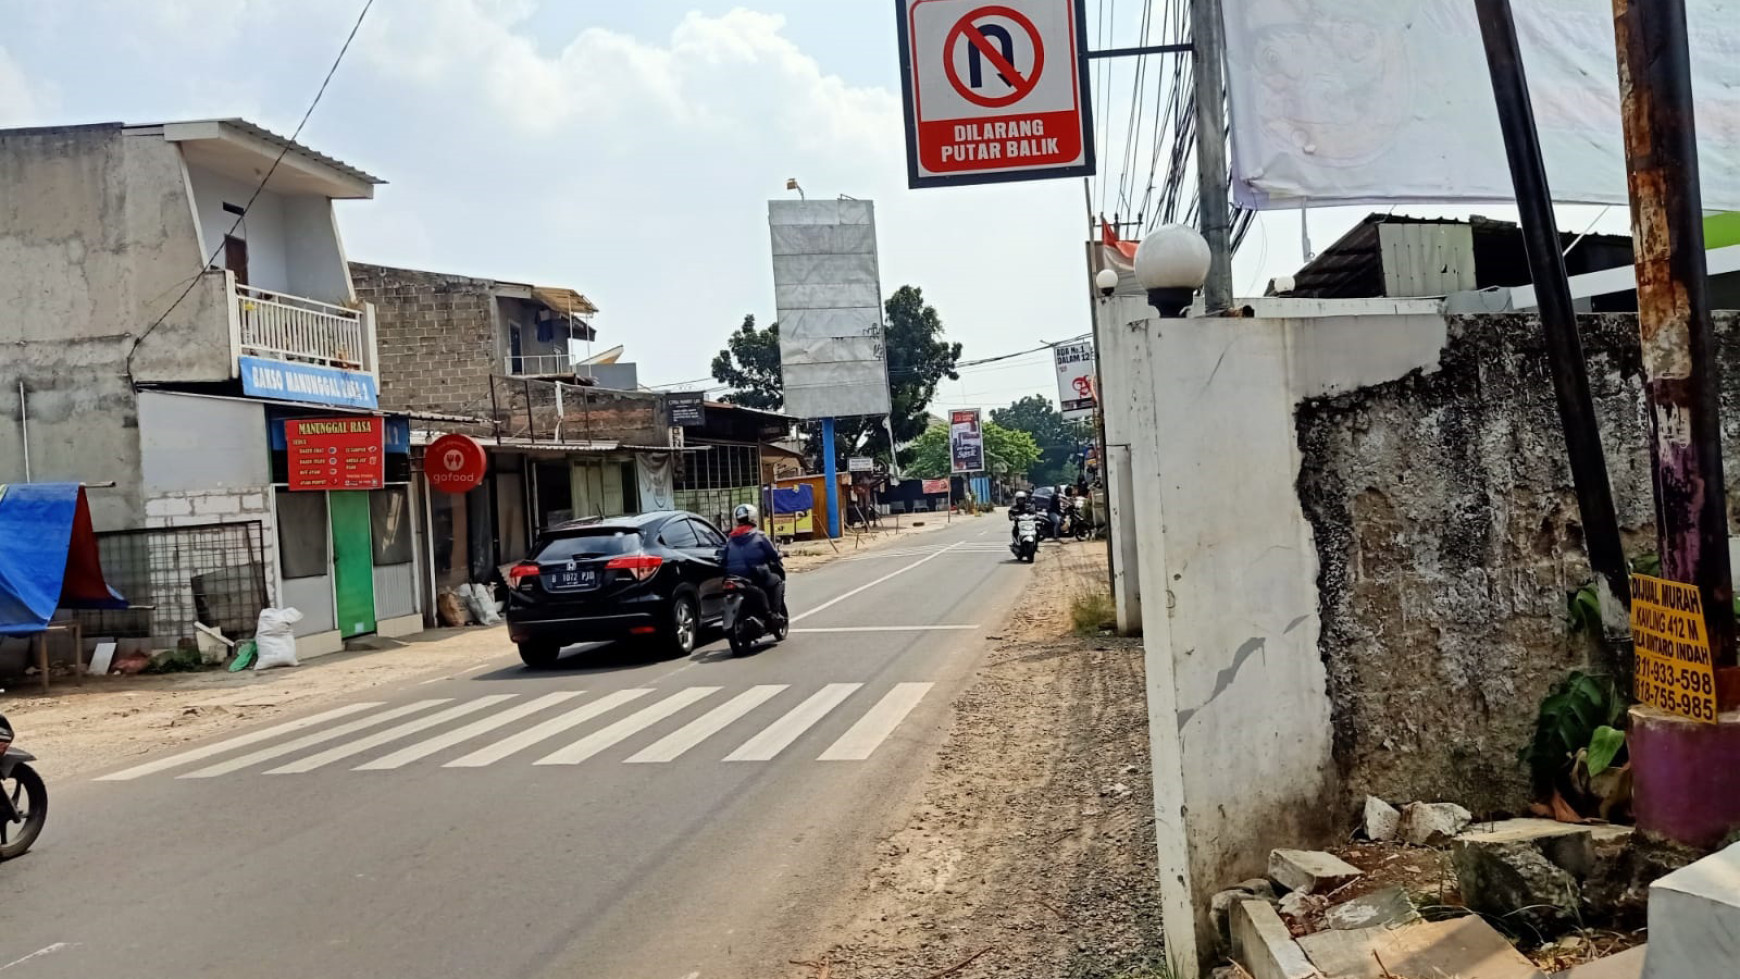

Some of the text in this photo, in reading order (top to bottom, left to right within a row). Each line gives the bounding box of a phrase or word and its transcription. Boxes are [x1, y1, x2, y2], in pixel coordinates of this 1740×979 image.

[954, 119, 1044, 142] DILARANG
[941, 137, 1059, 162] PUTAR BALIK
[1056, 347, 1069, 356] ADA
[252, 366, 283, 391] BAKSO
[285, 371, 341, 397] MANUNGGAL
[298, 420, 372, 435] MANUNGGAL RASA
[433, 472, 474, 485] gofood
[1632, 578, 1700, 614] DIJUAL MURAH
[1636, 606, 1699, 641] KAVLING 412 M
[1676, 642, 1710, 666] INDAH
